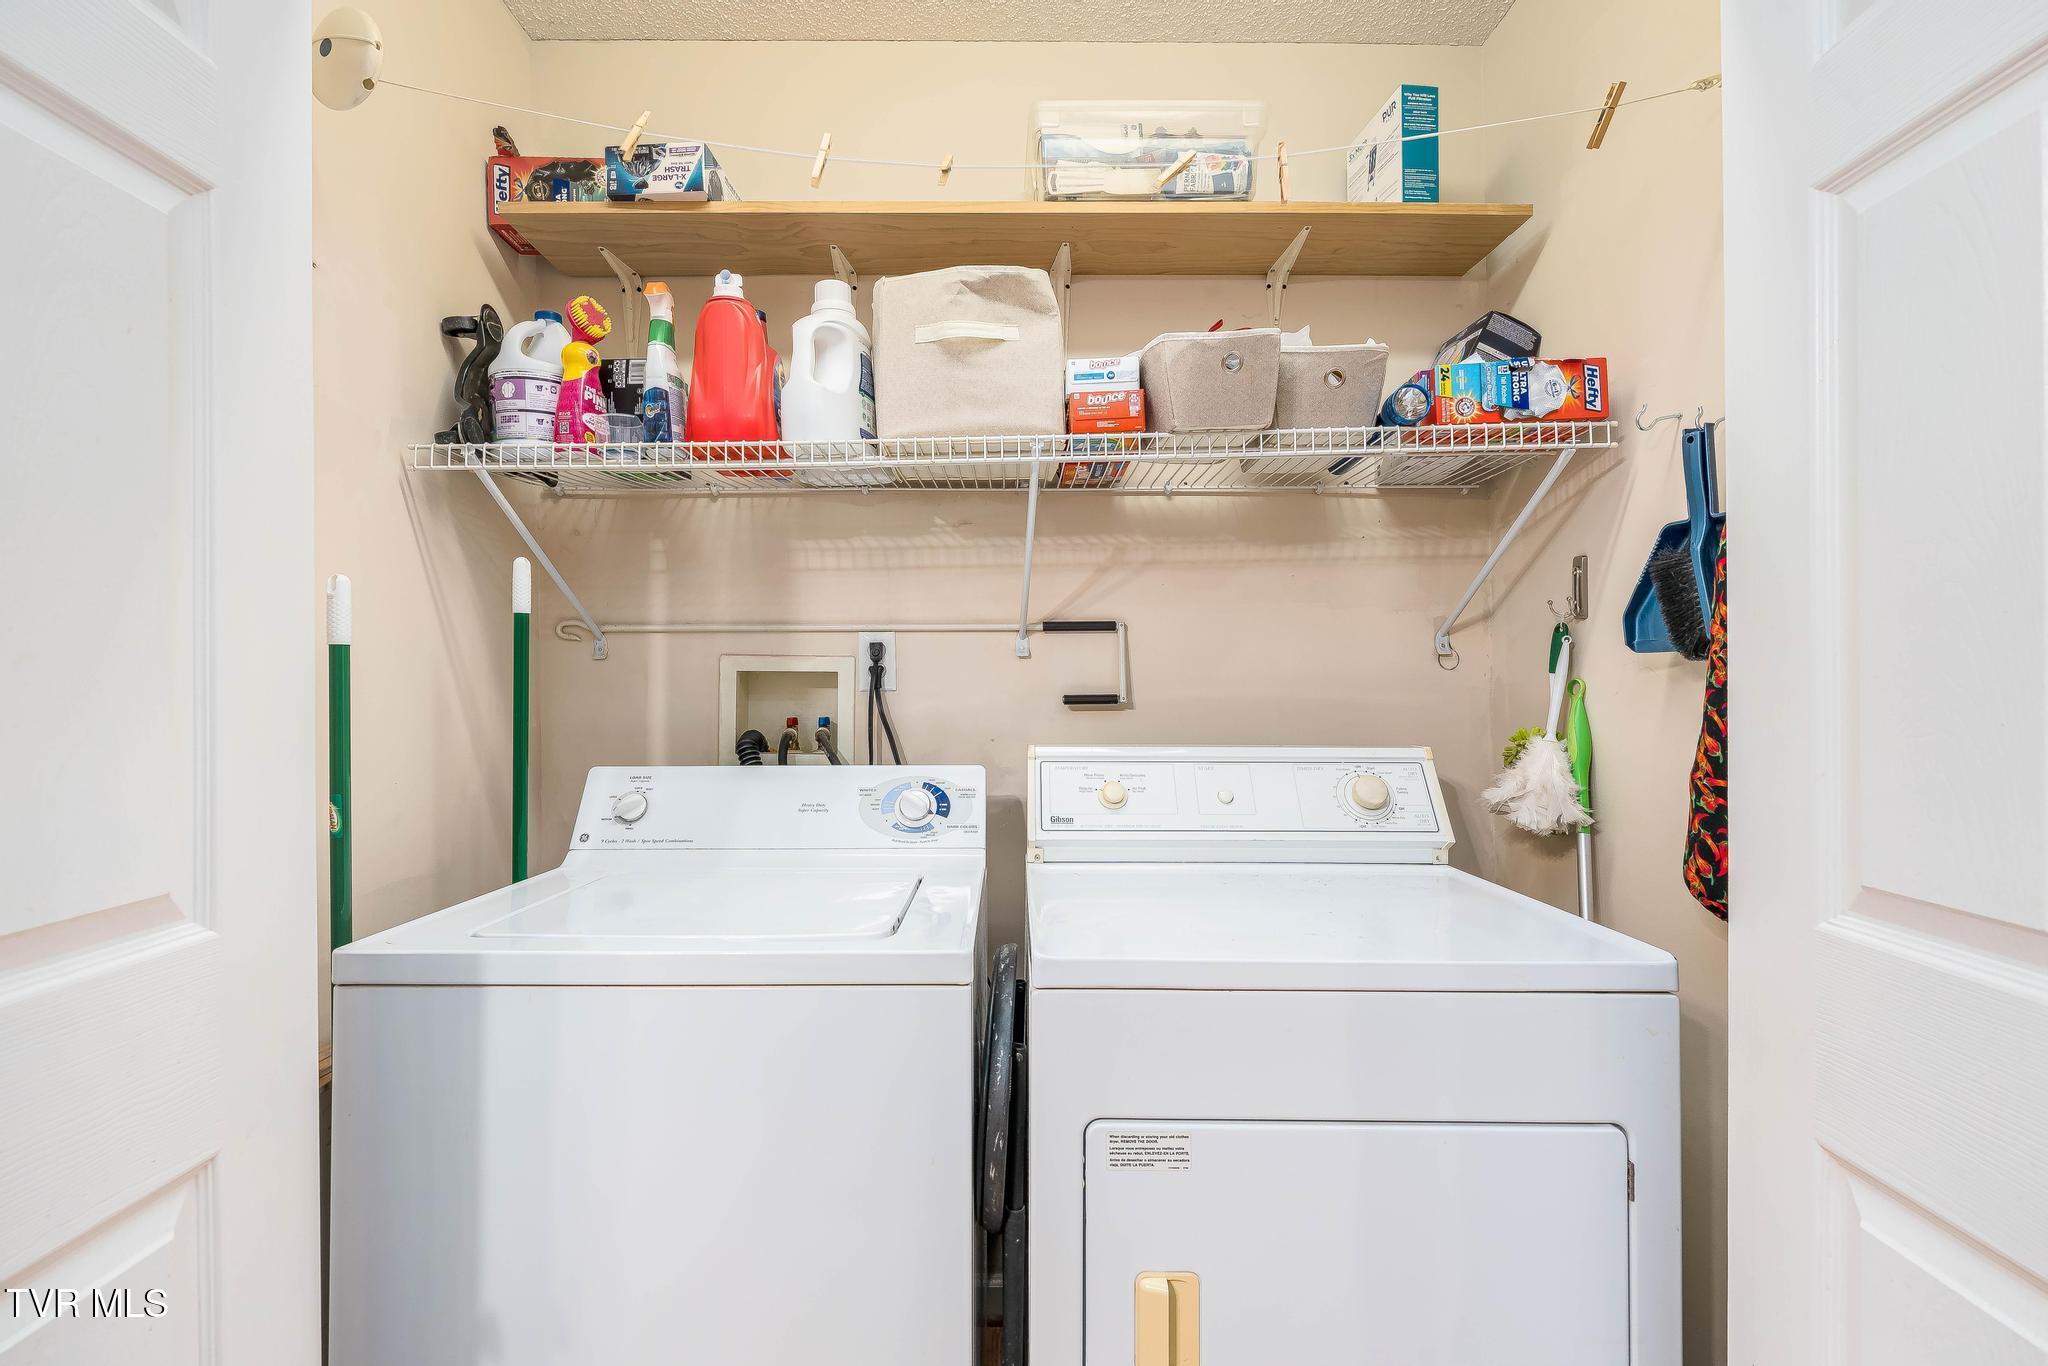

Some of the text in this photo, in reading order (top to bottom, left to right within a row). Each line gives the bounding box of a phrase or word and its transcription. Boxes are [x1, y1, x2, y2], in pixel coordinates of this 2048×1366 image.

[1382, 101, 1397, 123] PUR
[652, 173, 686, 182] X-LARGE
[1089, 359, 1120, 369] bounce
[1440, 367, 1450, 382] 24
[1585, 367, 1598, 409] Hefty
[1088, 391, 1125, 405] bounce
[1050, 815, 1074, 823] Gibson
